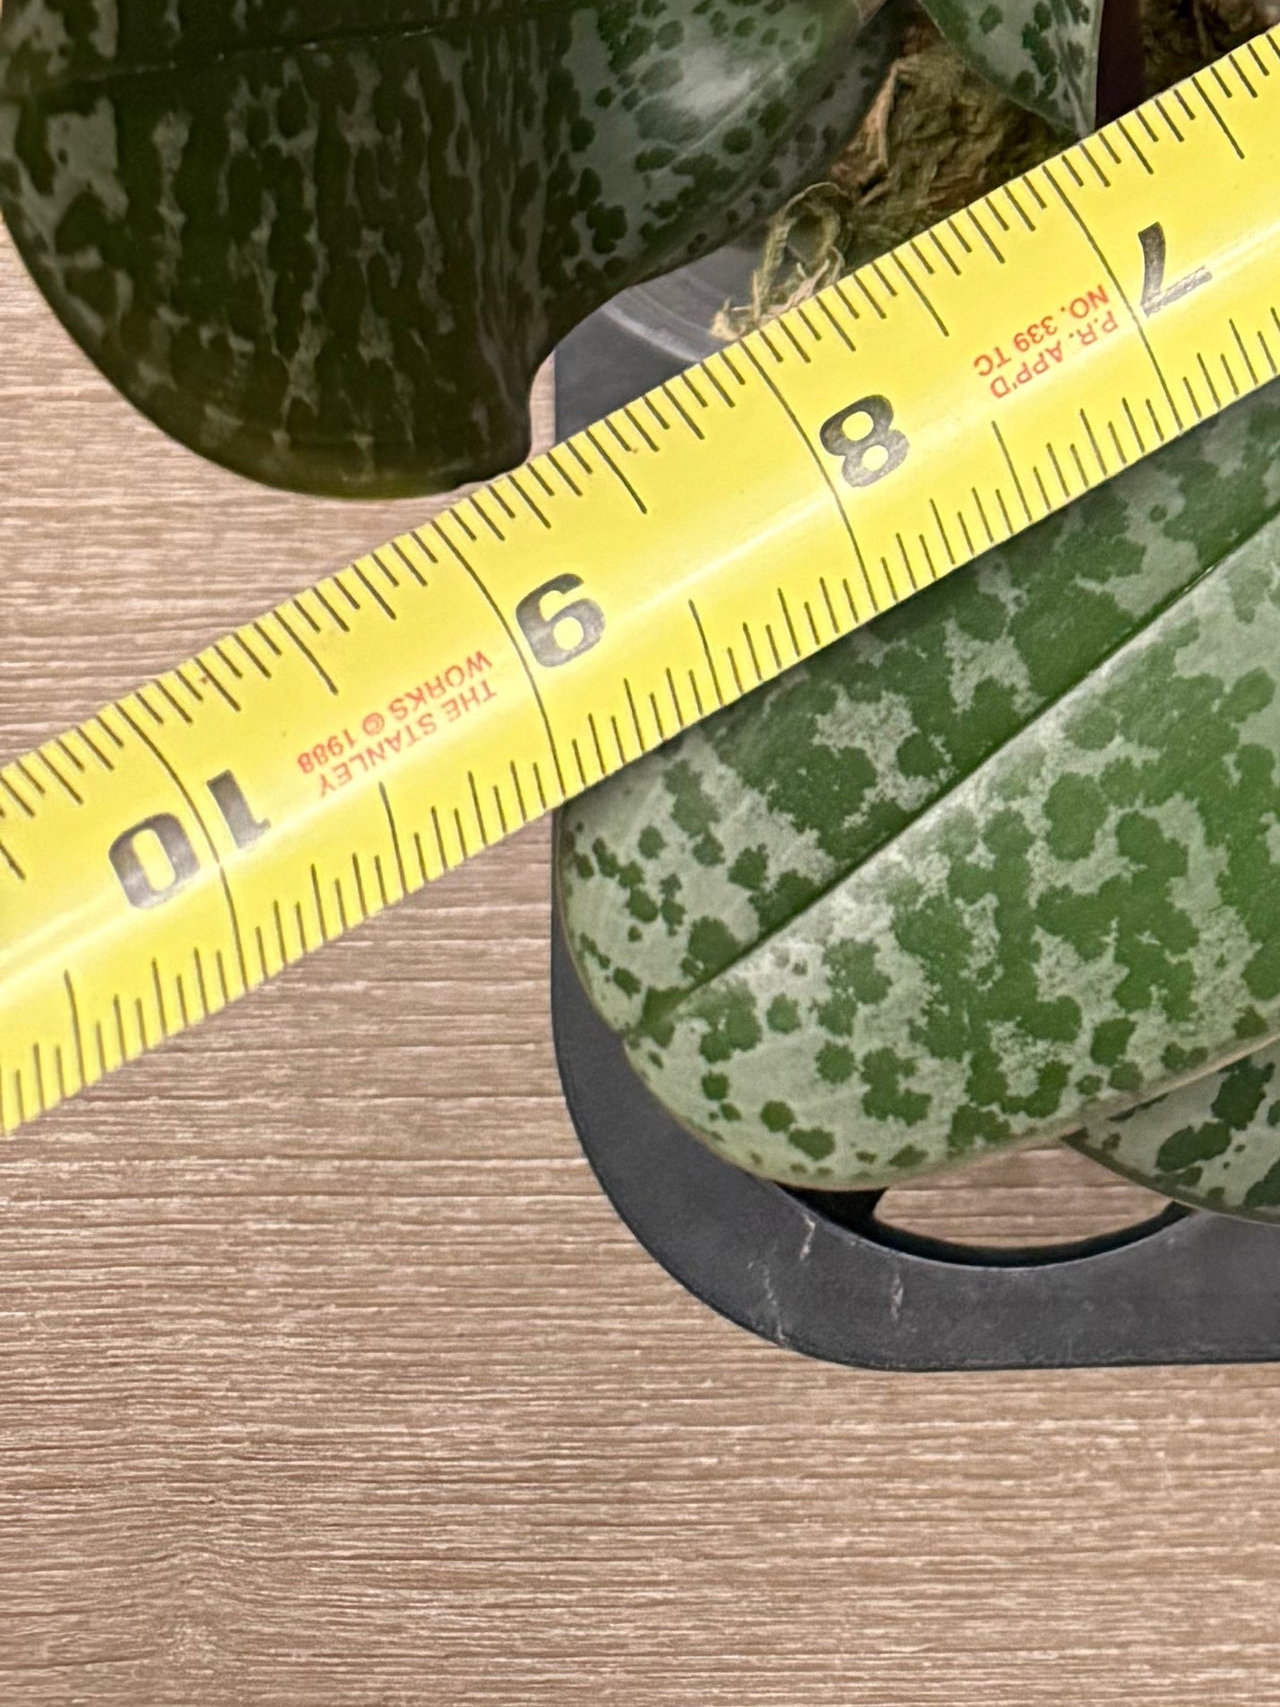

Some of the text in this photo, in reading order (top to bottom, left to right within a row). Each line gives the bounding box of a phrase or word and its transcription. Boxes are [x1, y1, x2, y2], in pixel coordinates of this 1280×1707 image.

[1137, 221, 1213, 319] 7
[973, 284, 1110, 377] NO. 339 TC
[990, 318, 1120, 398] P.R. APP'D
[819, 393, 911, 487] 8
[515, 571, 607, 669] 9
[386, 649, 493, 722] WORKS
[296, 729, 358, 776] 1988
[317, 679, 498, 798] THE STANLEY
[107, 769, 272, 910] 10
